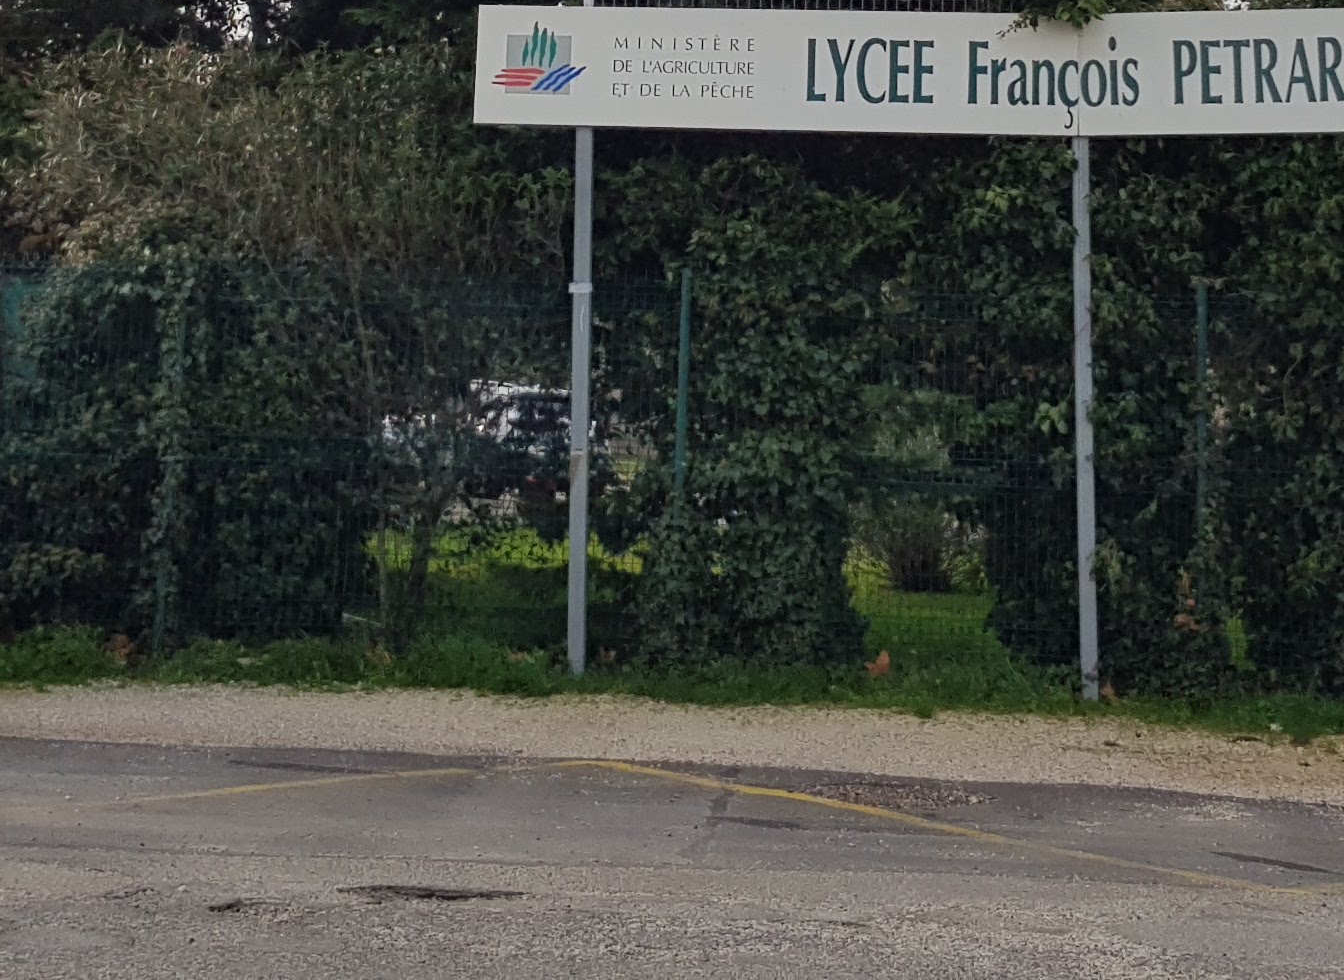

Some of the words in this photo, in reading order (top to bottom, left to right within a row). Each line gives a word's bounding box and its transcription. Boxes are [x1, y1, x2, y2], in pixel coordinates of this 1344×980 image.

[613, 34, 755, 52] MINISTÈRE
[613, 59, 633, 73] DE
[642, 59, 755, 75] L'AGRICULTURE
[612, 82, 630, 96] ET
[639, 83, 662, 97] DE
[672, 84, 691, 98] LA
[700, 81, 755, 99] PÊCHE
[806, 37, 935, 104] LYCEE
[967, 35, 1140, 130] François
